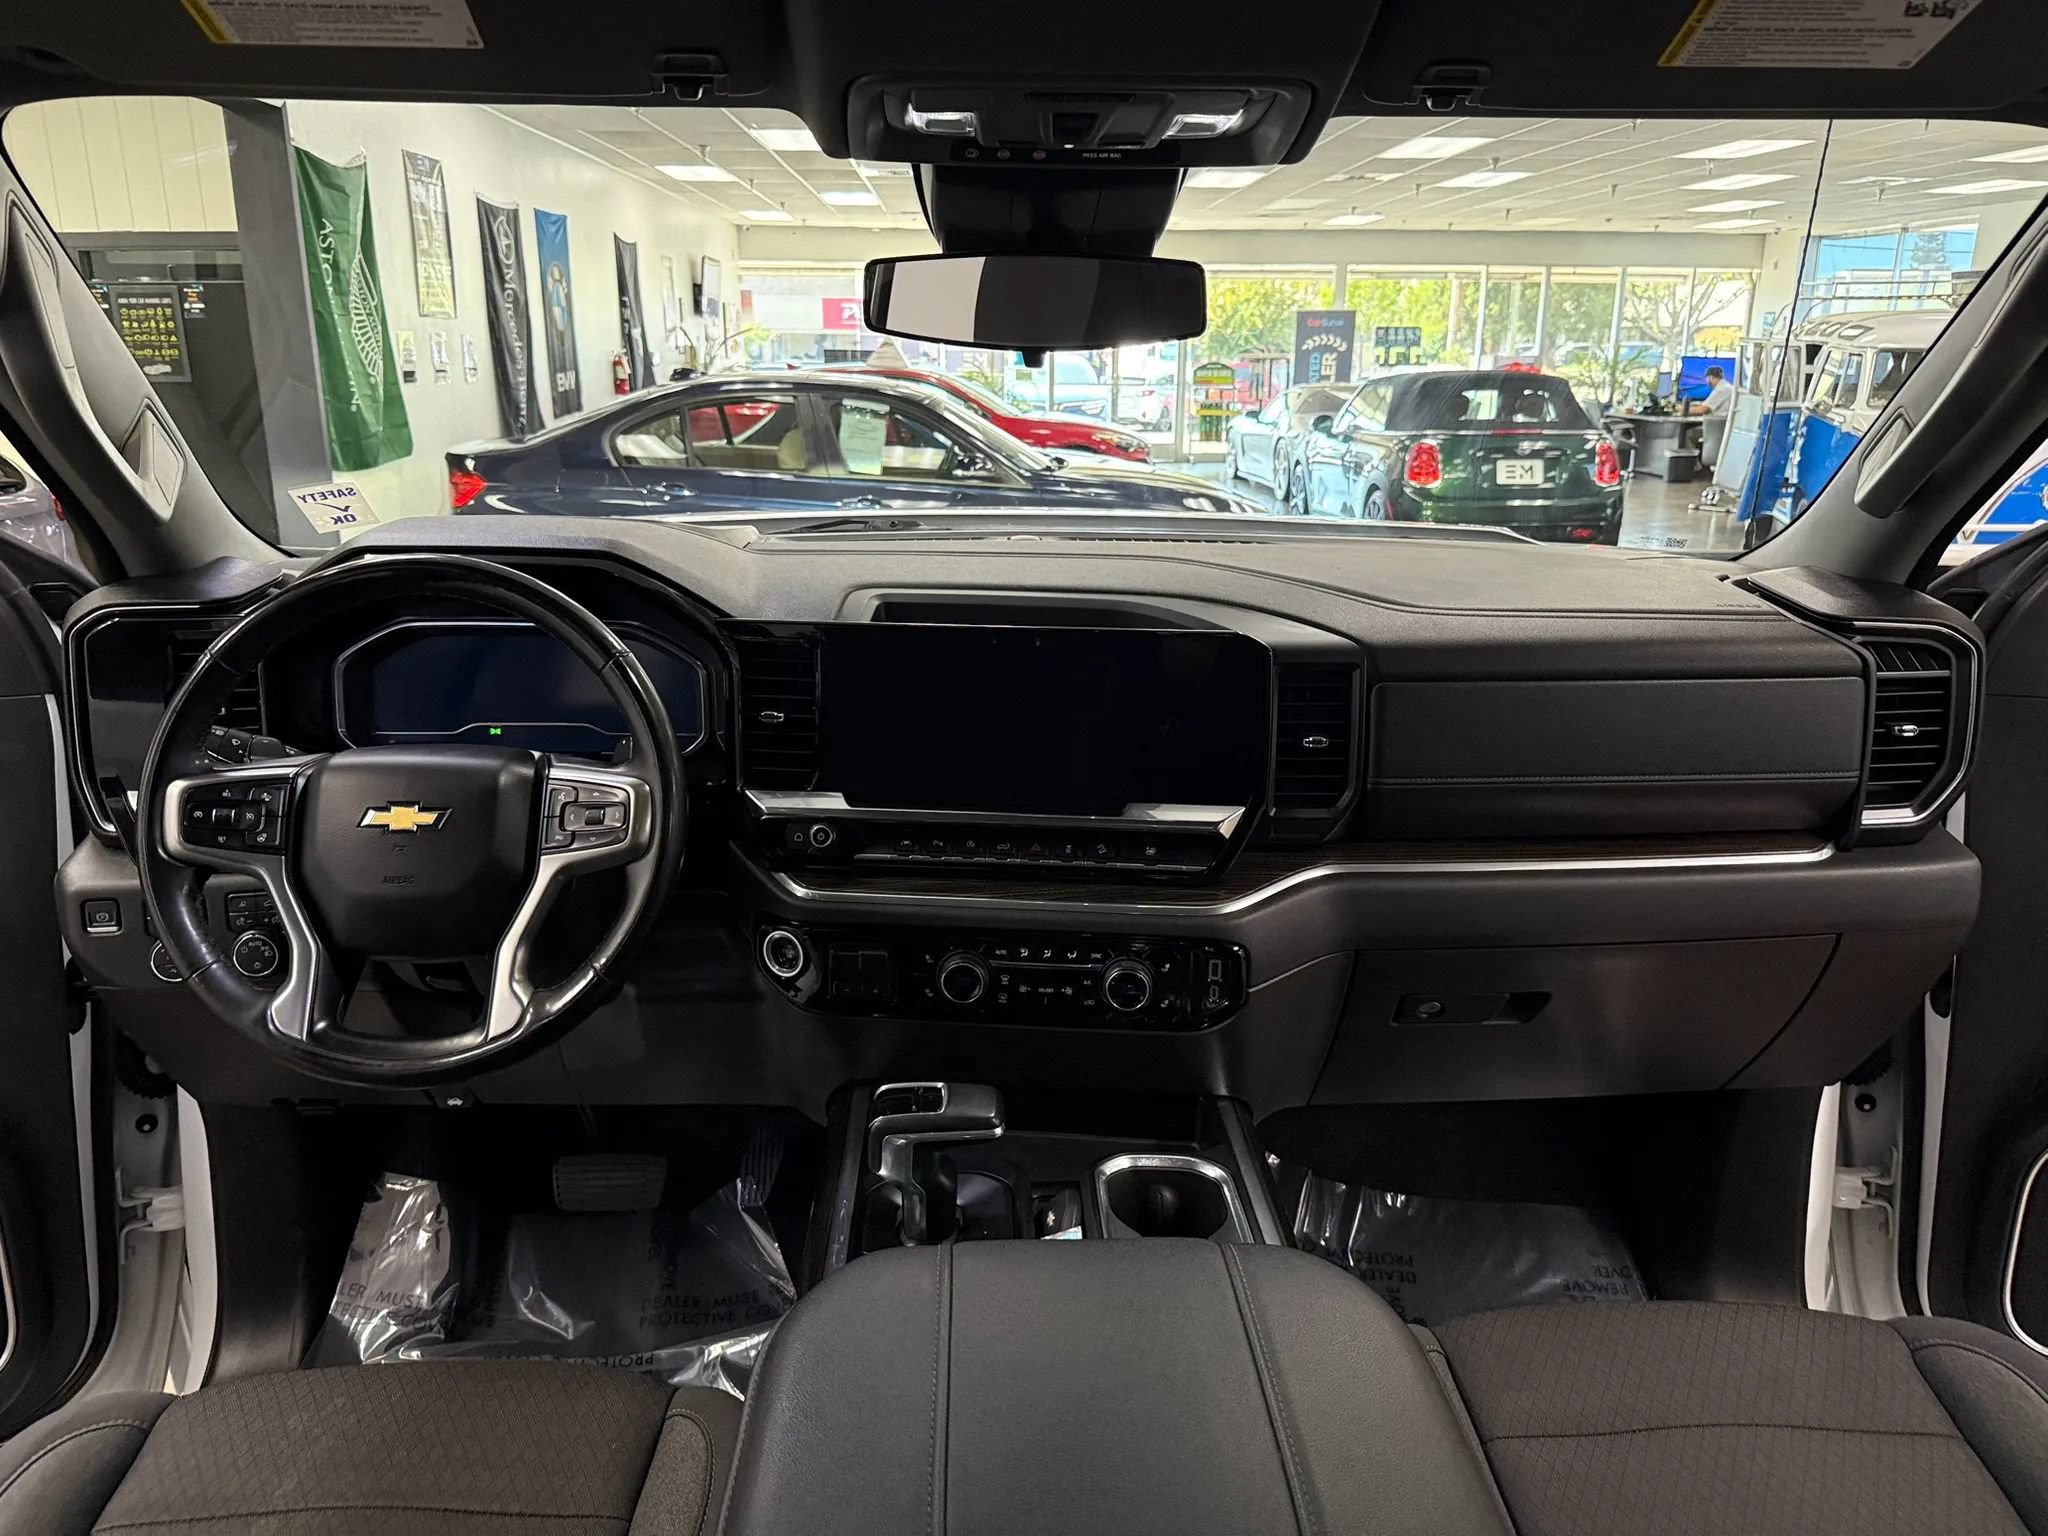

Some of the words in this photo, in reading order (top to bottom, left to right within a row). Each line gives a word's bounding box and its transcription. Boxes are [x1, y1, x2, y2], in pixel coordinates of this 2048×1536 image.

[1109, 152, 1122, 160] BAG
[555, 369, 576, 393] BMW
[1358, 1267, 1417, 1285] DEALER
[1562, 1278, 1631, 1297] REMOVE
[375, 1288, 425, 1310] MUST
[640, 1294, 702, 1312] DEALER
[712, 1287, 760, 1308] MUST
[638, 1309, 738, 1330] PROTECTIVE
